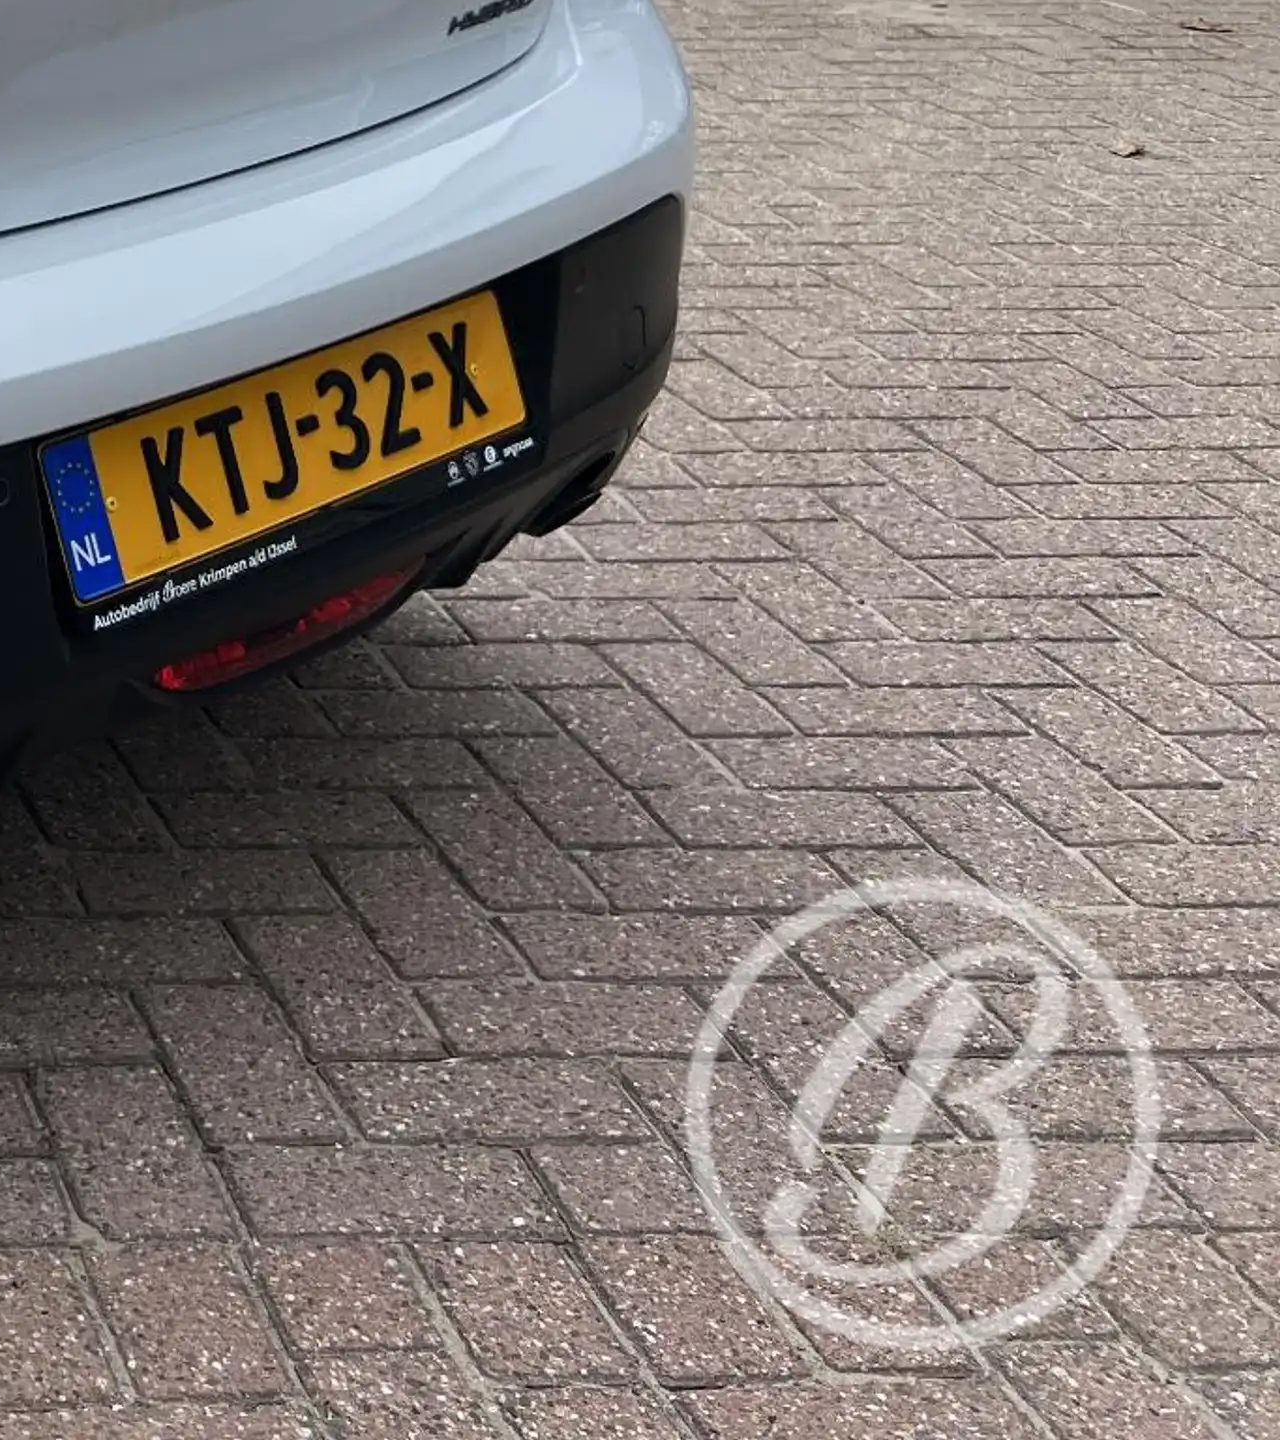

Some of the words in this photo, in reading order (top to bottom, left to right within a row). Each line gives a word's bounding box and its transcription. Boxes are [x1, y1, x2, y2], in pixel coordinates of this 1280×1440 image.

[140, 320, 489, 544] KTJ-32-X
[70, 532, 112, 572] NL
[93, 589, 161, 631] Autobedrijf
[199, 559, 248, 588] Krimpen
